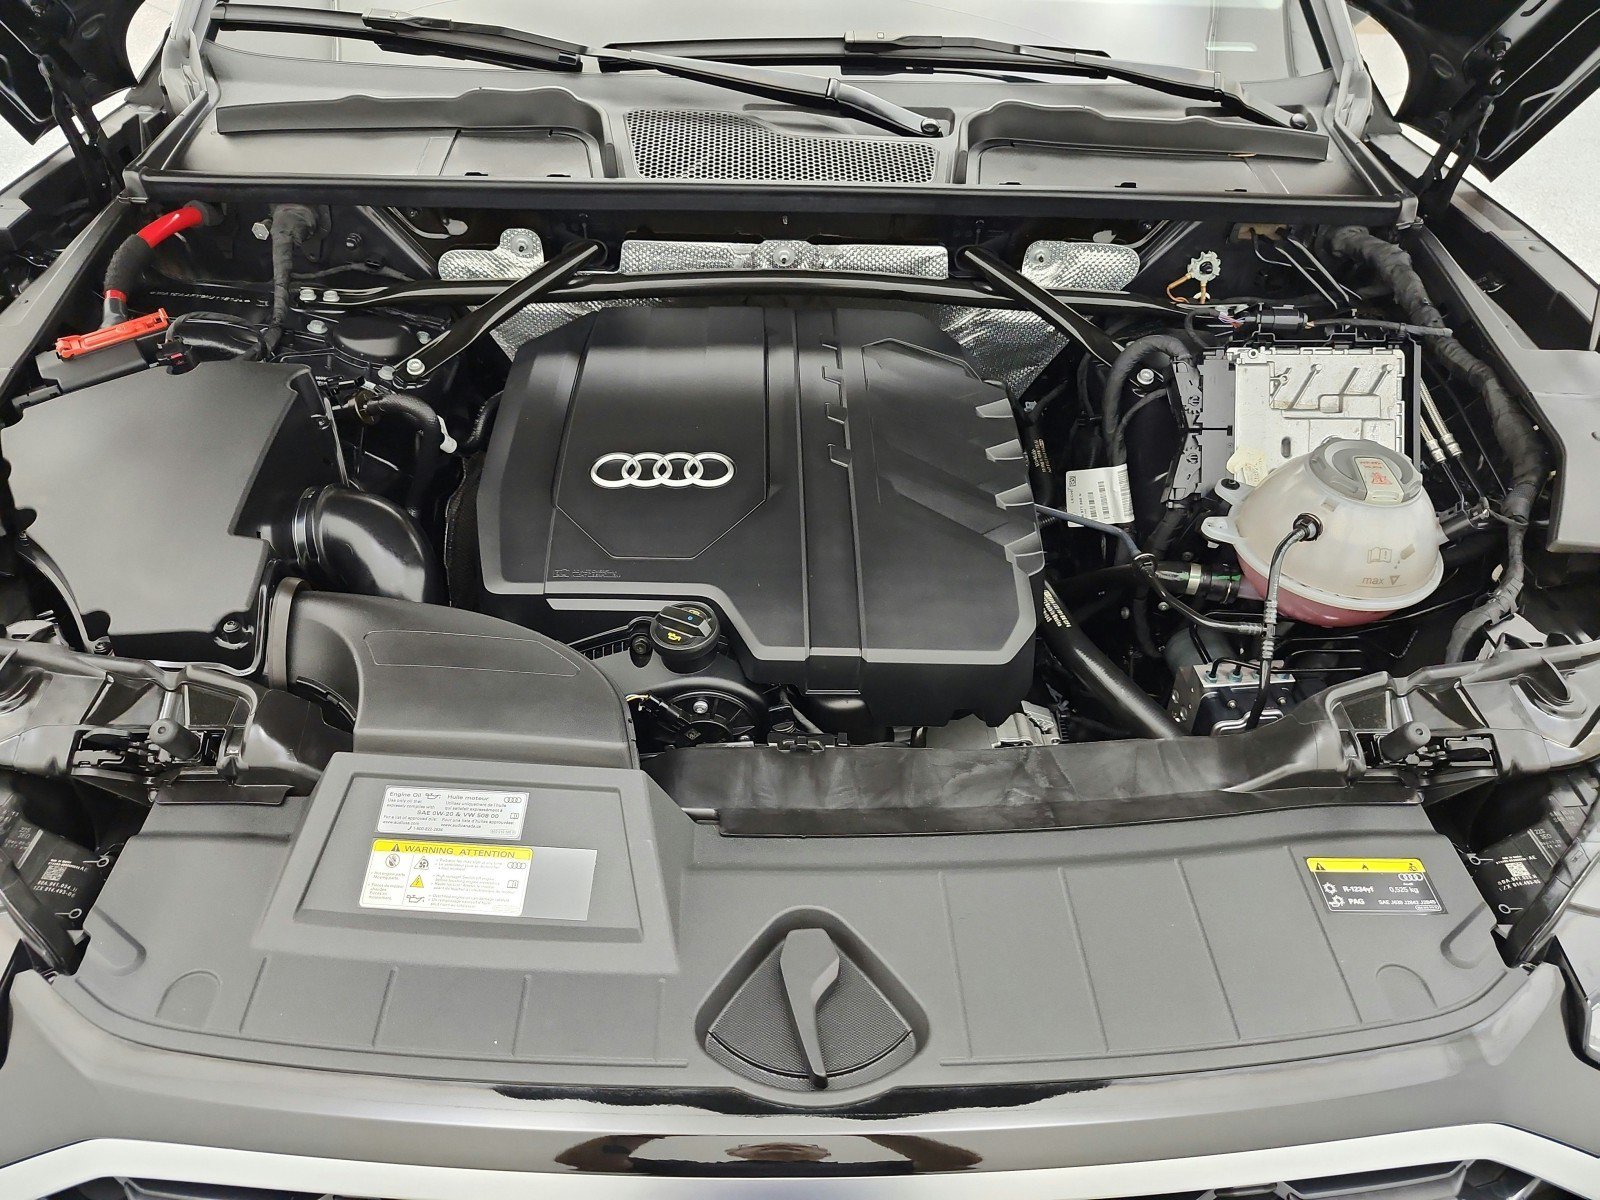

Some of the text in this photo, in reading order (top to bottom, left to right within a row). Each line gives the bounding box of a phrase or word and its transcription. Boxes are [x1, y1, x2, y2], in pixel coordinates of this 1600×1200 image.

[1362, 577, 1385, 585] max
[404, 845, 515, 859] WARNING ATTENTION
[1342, 885, 1375, 894] R-1234yf
[1410, 886, 1420, 894] kg
